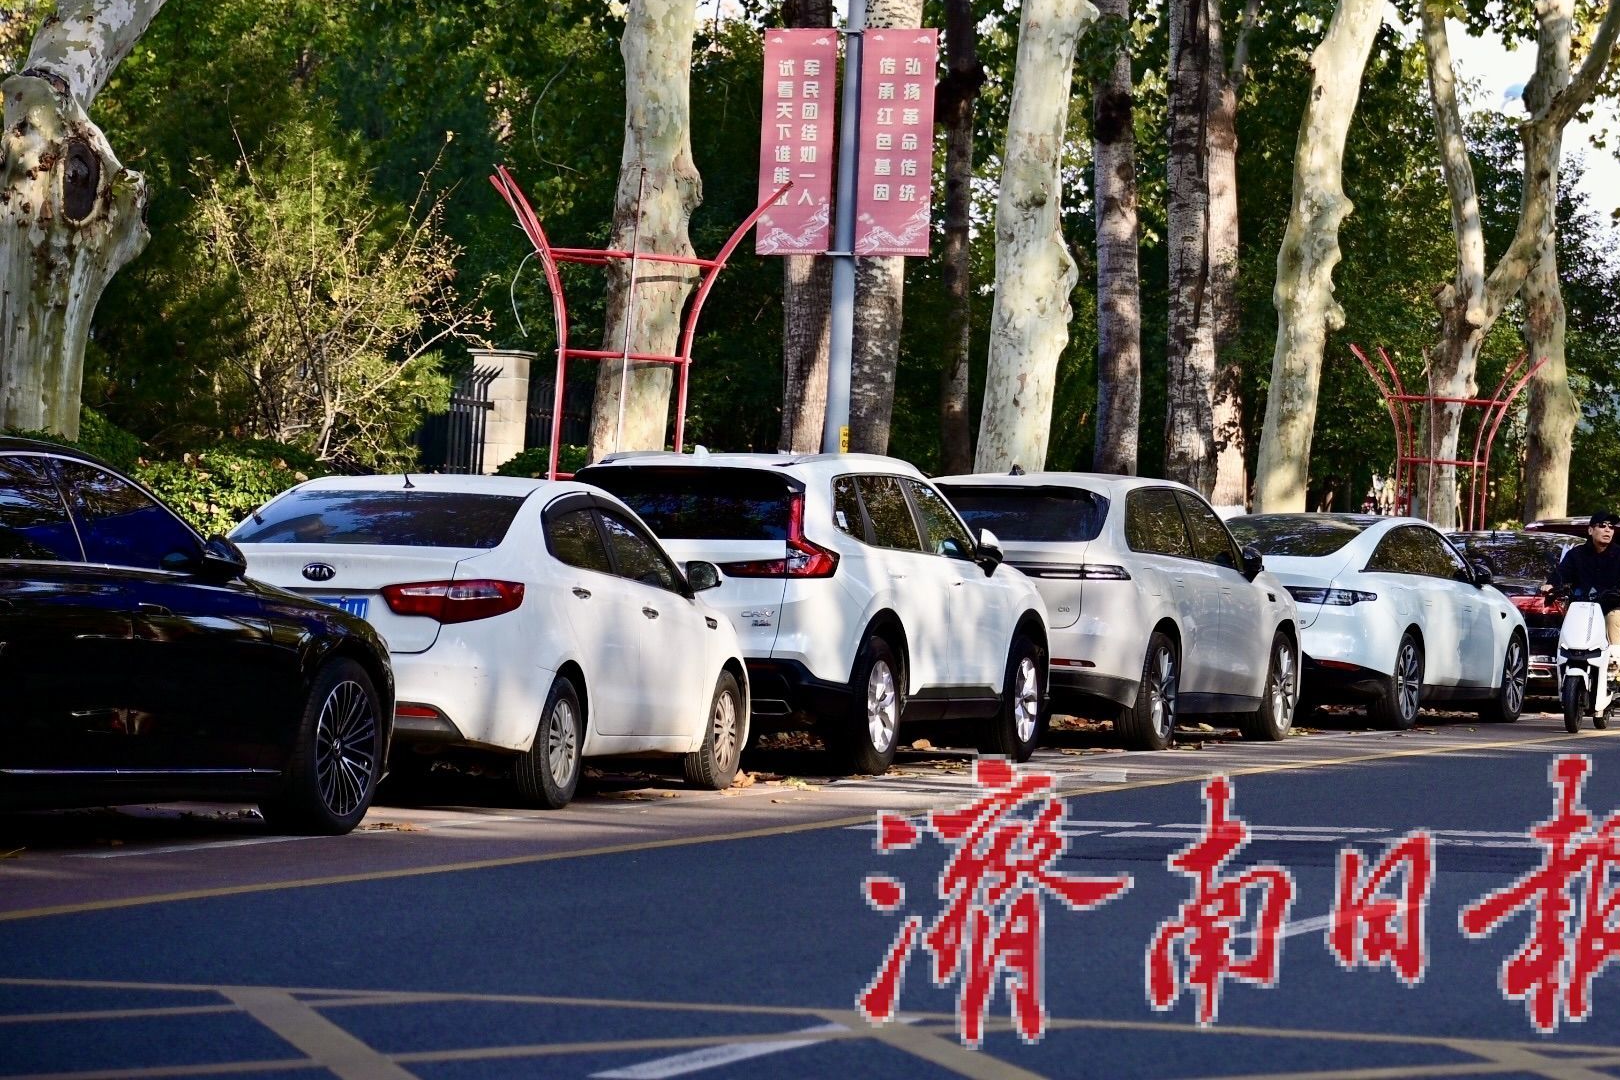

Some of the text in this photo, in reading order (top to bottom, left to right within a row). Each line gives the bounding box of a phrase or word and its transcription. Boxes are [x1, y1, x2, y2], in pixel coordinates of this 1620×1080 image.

[798, 59, 820, 206] 军民团结如一人
[873, 58, 896, 201] 传承红色基因
[899, 58, 921, 202] 弘扬革命传统
[307, 567, 329, 578] KIA
